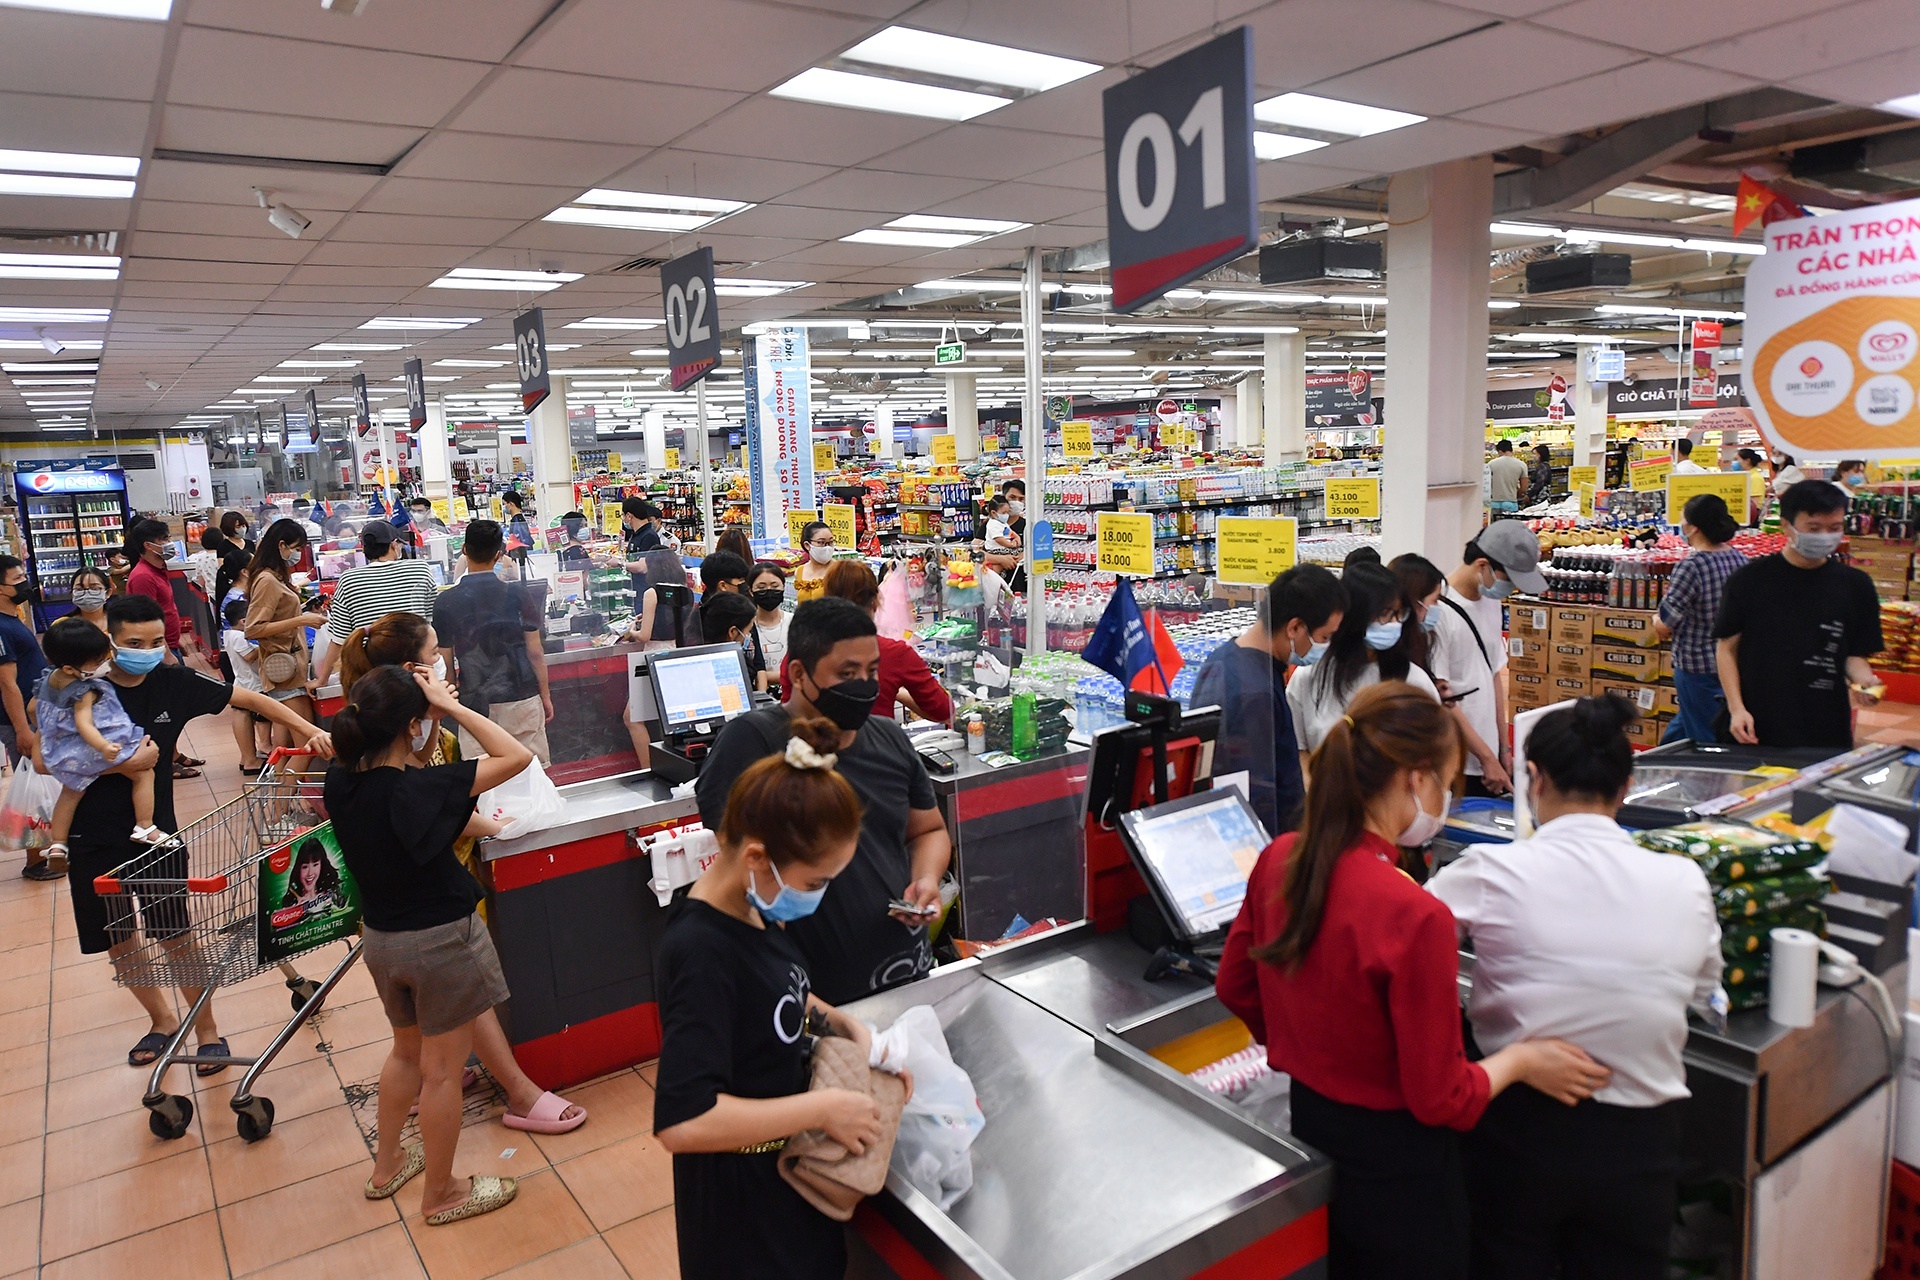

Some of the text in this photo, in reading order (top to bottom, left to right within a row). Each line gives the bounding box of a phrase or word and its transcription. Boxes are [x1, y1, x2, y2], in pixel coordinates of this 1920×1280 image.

[1117, 84, 1226, 232] 01
[1772, 225, 1841, 252] TRÂN
[1798, 240, 1916, 275] CÁC NHÀ
[666, 276, 711, 349] 02
[518, 328, 542, 382] 03
[406, 373, 421, 410] 04
[1617, 390, 1639, 403] GIÒ
[1640, 387, 1666, 402] CHẢ
[354, 385, 367, 417] 05
[1507, 402, 1532, 411] products
[1067, 441, 1091, 451] 34.900
[65, 473, 110, 490] pepsi
[1329, 493, 1358, 501] 43.100
[1331, 507, 1360, 515] 35.000
[829, 519, 849, 530] 26.900
[1103, 531, 1133, 543] 18.000
[1101, 553, 1131, 566] 43.000
[1560, 612, 1584, 621] CHIN-SU
[1607, 618, 1644, 630] CHIN-SU
[1558, 645, 1582, 655] CHIN-SU
[1606, 653, 1643, 665] CHIN-SU
[1517, 674, 1541, 684] CHIN-SU
[1558, 679, 1582, 688] CHIN-SU
[271, 856, 290, 864] Colgate
[272, 909, 302, 924] Colgate
[277, 935, 295, 946] TINH
[295, 925, 313, 940] CHẤT
[313, 921, 332, 934] THAN
[331, 918, 344, 928] TRE
